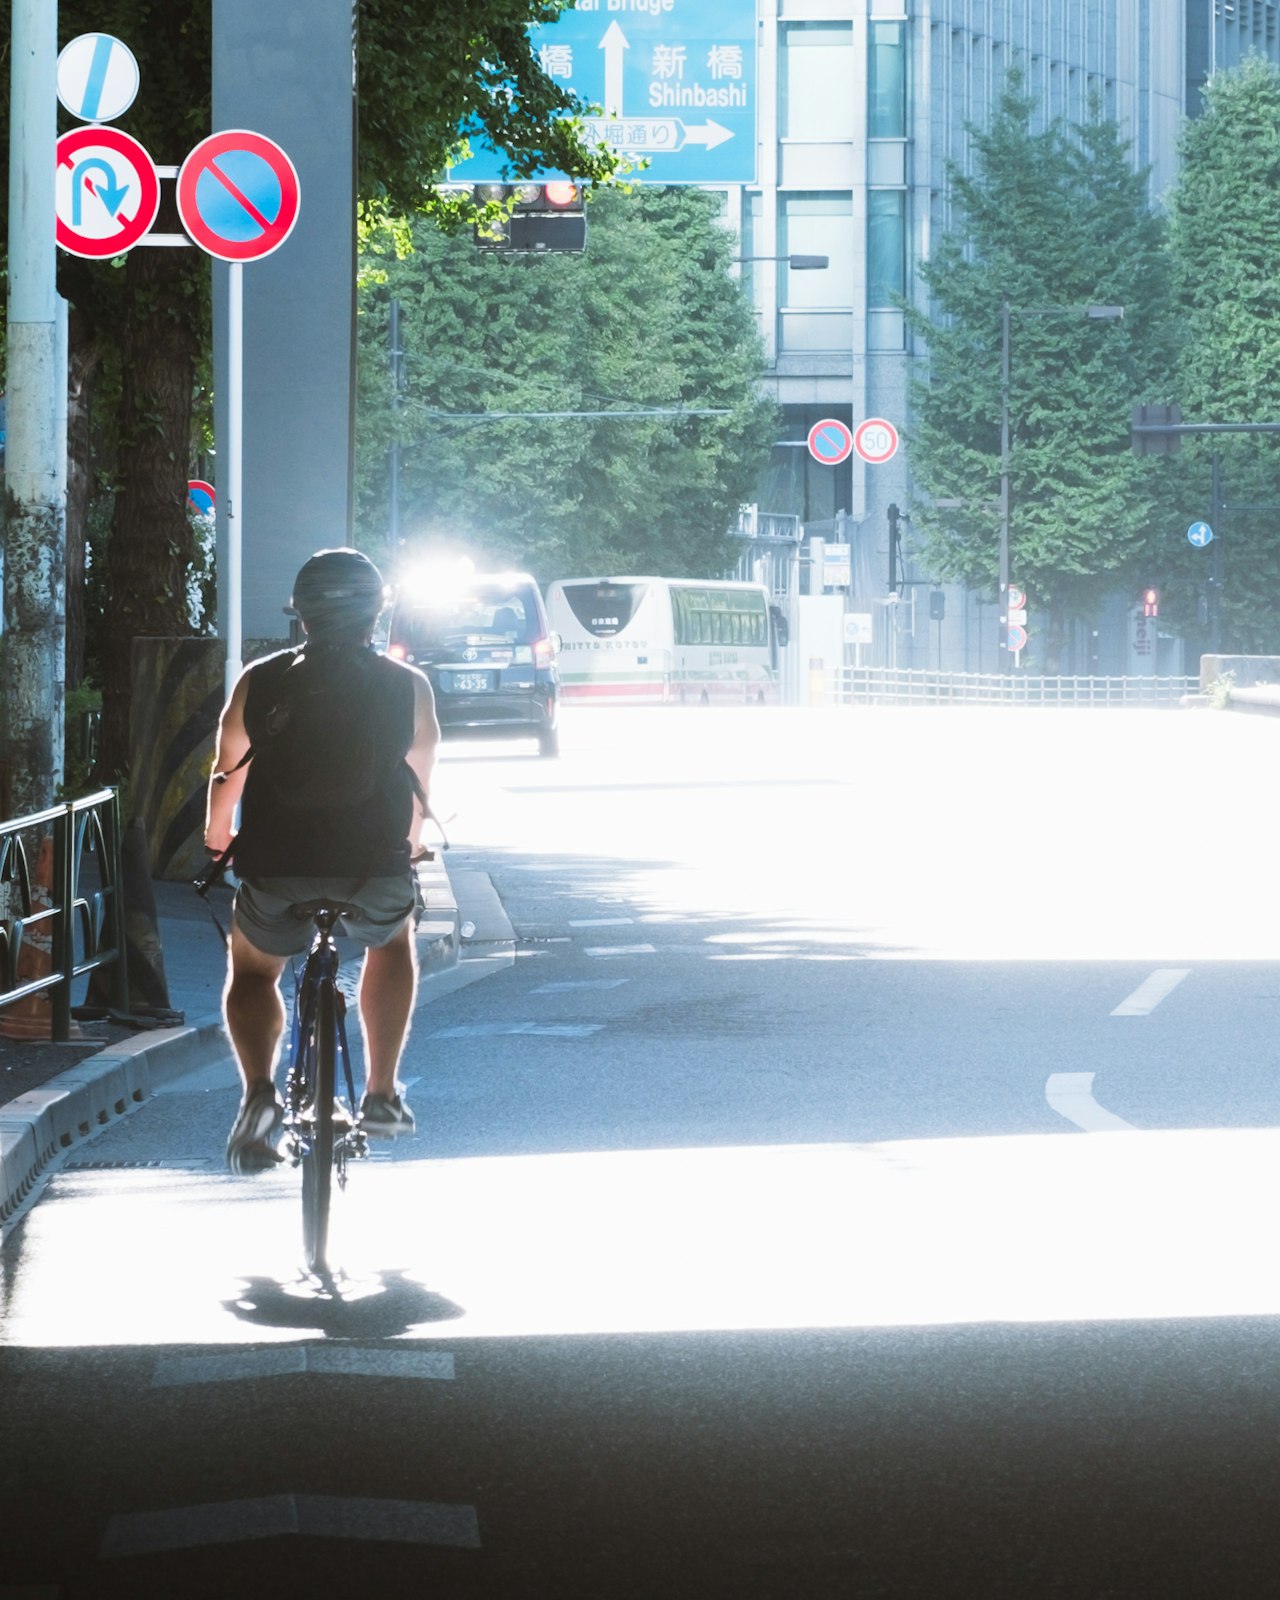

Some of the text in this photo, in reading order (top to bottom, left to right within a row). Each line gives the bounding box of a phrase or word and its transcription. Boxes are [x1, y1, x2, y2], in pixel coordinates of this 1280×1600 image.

[652, 44, 743, 81] 新橋
[649, 82, 747, 108] Shinbashi
[583, 123, 670, 145] 外堀通り
[864, 431, 888, 451] 50
